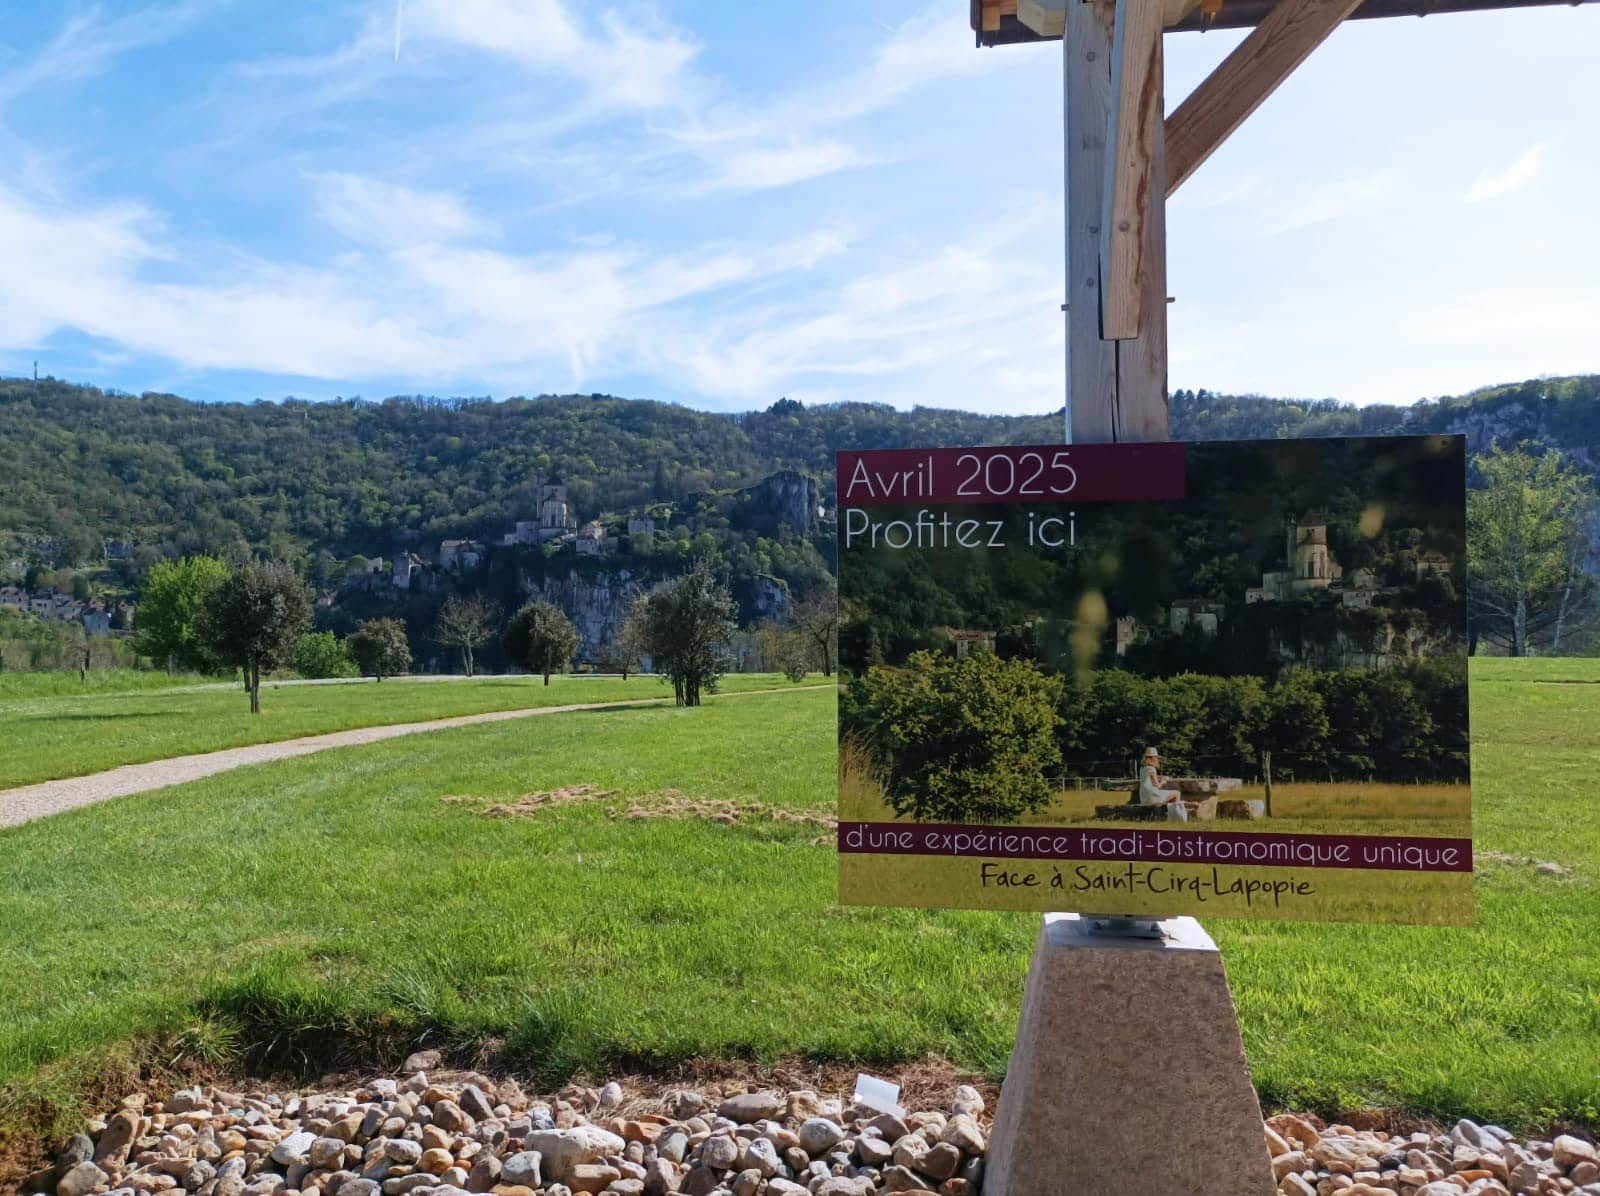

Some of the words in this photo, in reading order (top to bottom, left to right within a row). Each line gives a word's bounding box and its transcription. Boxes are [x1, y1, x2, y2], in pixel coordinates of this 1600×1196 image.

[846, 456, 934, 498] Avril
[956, 452, 1077, 495] 2025
[846, 508, 1006, 549] Profitez
[1028, 511, 1076, 547] ici
[846, 824, 914, 849] d'une
[925, 830, 1069, 854] expérience
[1080, 832, 1351, 866] tradi-bistronomique
[1363, 843, 1459, 869] unique
[980, 862, 1041, 889] Face
[1051, 866, 1064, 890] à
[1073, 862, 1315, 907] Saint-Cirq-Lapopie
